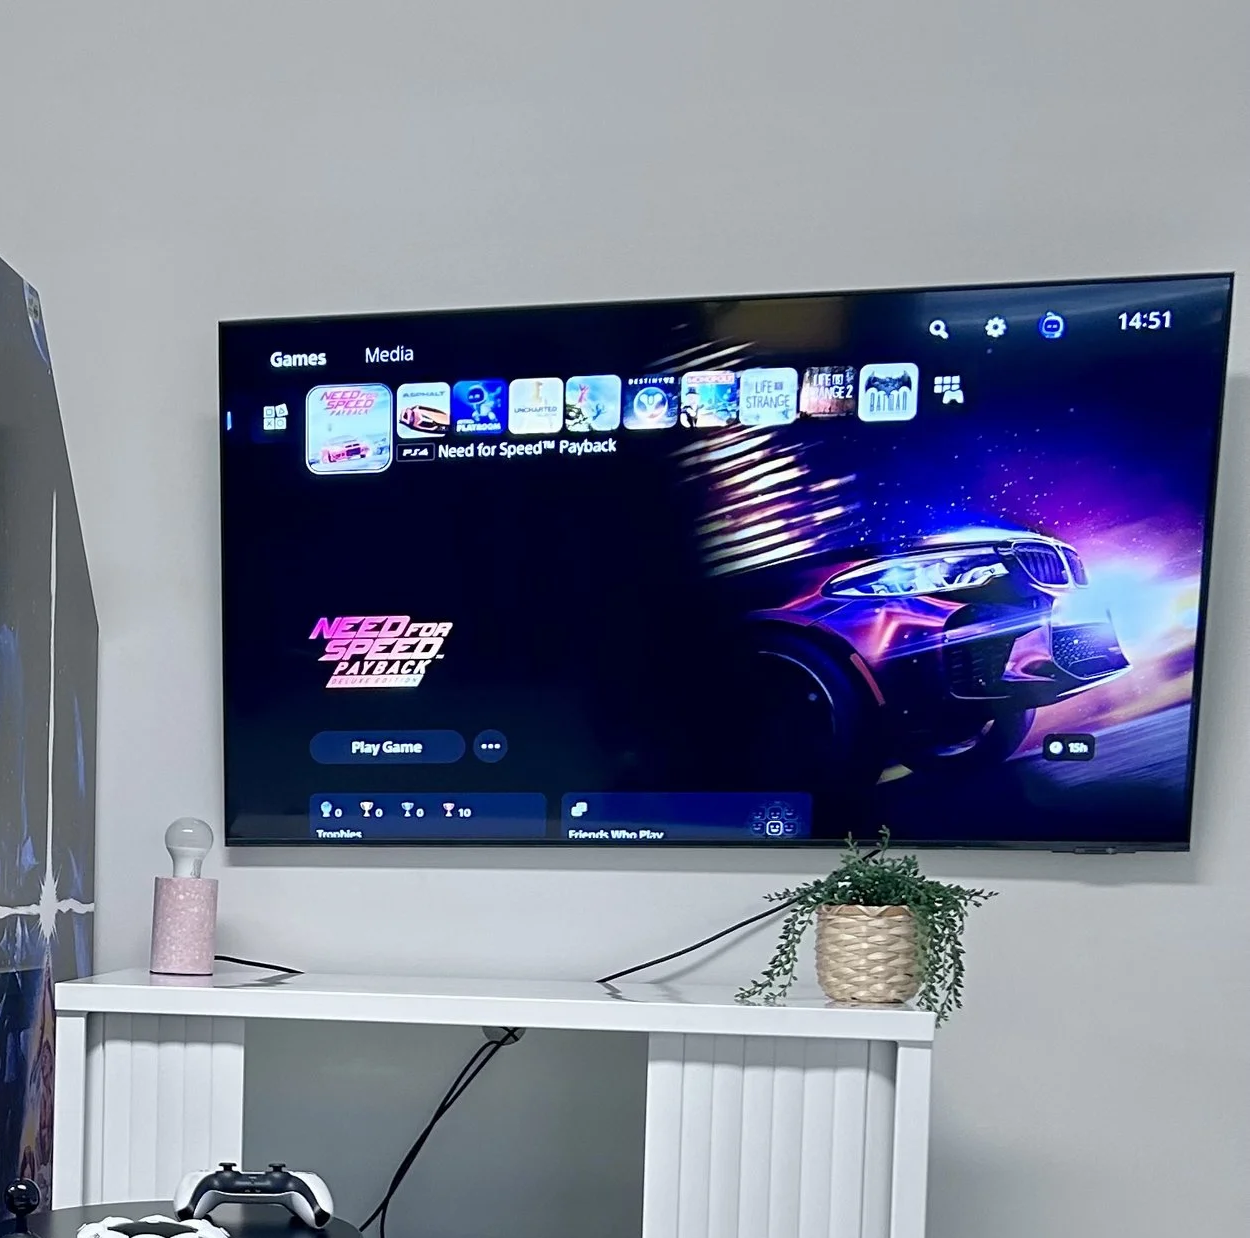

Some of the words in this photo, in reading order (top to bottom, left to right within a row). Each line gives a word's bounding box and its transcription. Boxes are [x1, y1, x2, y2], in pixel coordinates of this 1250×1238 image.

[1118, 310, 1172, 331] 14:51
[270, 351, 327, 368] Games
[365, 345, 414, 363] Media
[745, 394, 790, 409] STRANGE
[402, 448, 429, 457] PS4
[438, 444, 474, 458] Need
[477, 442, 496, 457] for
[559, 438, 617, 457] Payback
[308, 615, 411, 640] NEED
[404, 622, 454, 638] FOR
[318, 637, 444, 661] SPEED
[333, 660, 432, 675] PAYBACK
[351, 741, 380, 756] Play
[382, 741, 423, 754] Game
[1068, 743, 1088, 754] 15h
[334, 809, 343, 818] 0
[375, 809, 384, 818] 0
[416, 808, 425, 818] 0
[458, 808, 472, 818] 10
[568, 829, 609, 839] Friends
[611, 829, 637, 839] Who
